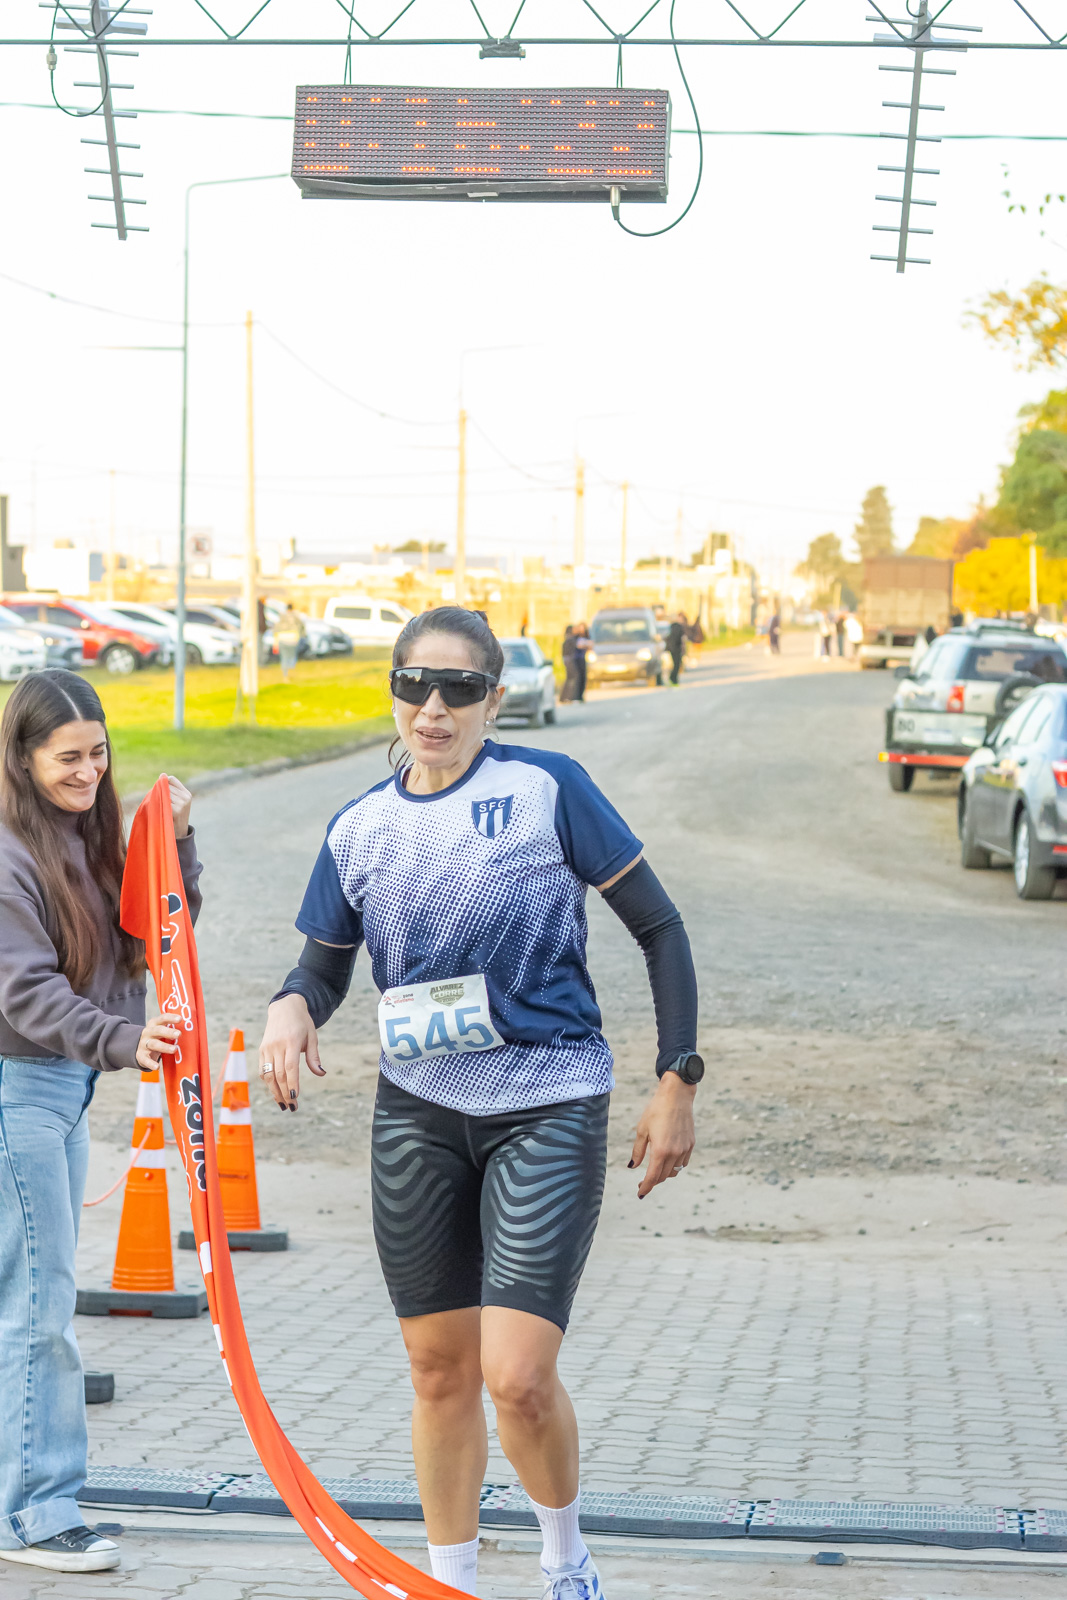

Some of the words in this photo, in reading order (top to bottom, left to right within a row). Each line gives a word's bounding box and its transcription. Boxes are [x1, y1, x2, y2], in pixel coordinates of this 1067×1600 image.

[478, 799, 506, 813] SFC
[430, 983, 464, 995] ALVAREZ
[433, 988, 464, 1000] CORRE
[385, 1005, 495, 1061] 545
